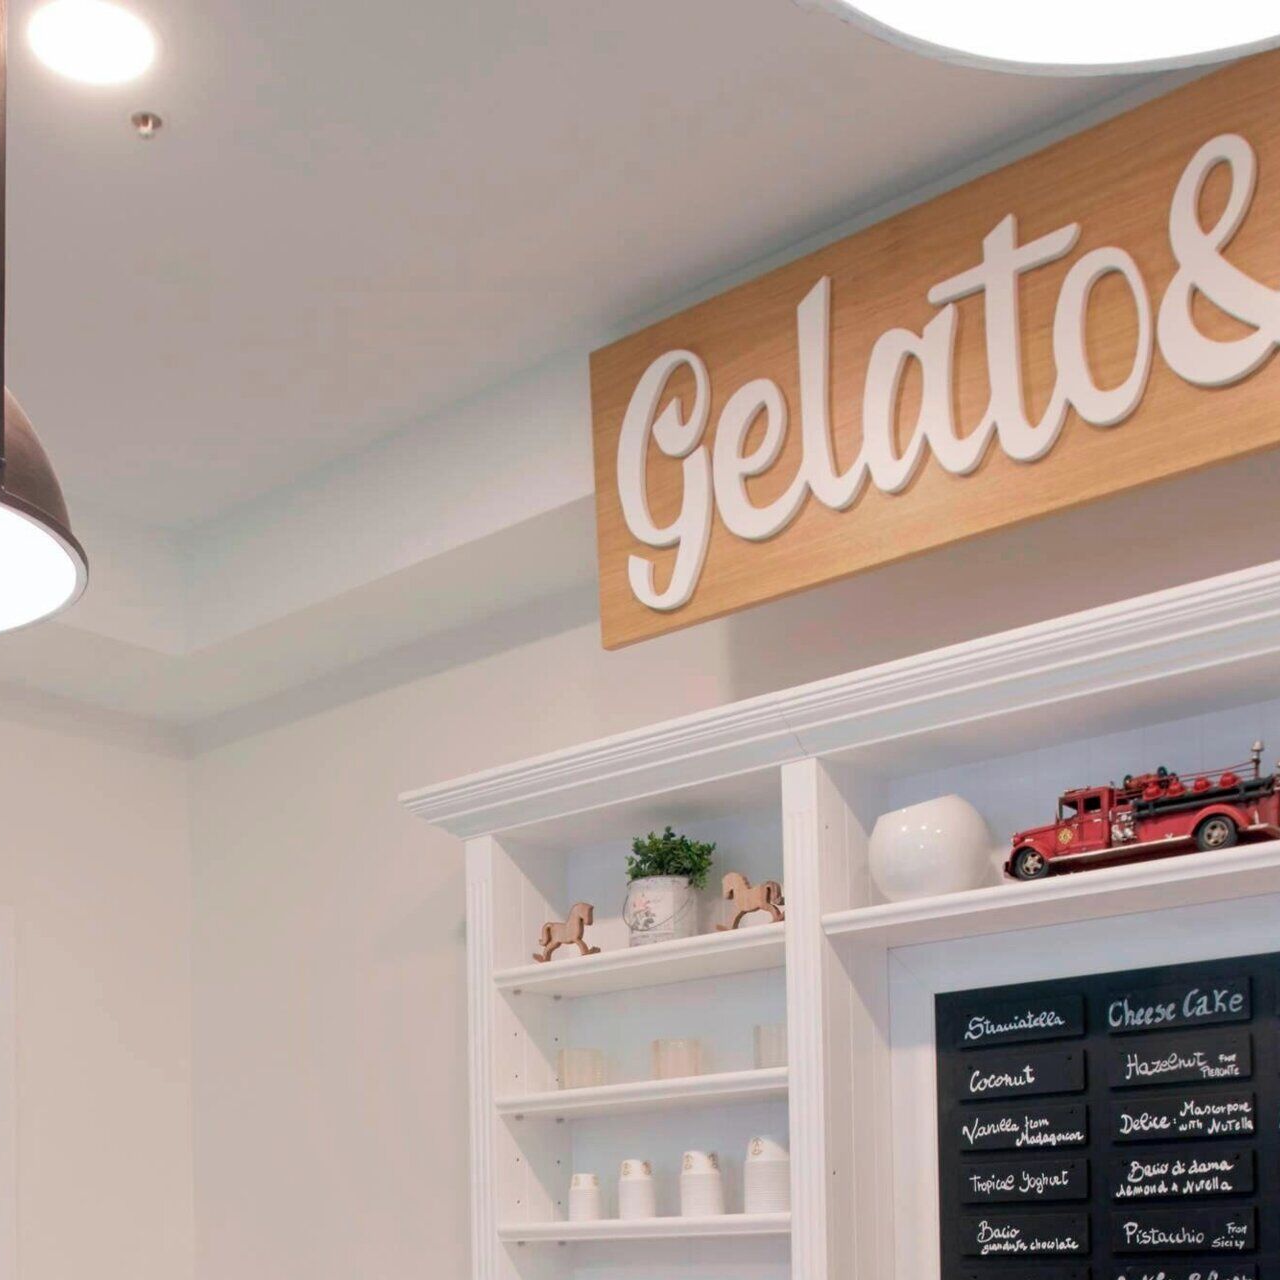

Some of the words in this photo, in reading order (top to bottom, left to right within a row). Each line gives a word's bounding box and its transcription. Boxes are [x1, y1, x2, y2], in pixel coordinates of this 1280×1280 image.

[1108, 998, 1177, 1027] Cheese
[969, 1065, 1036, 1093] Coconut
[1125, 1052, 1208, 1080] Hazelnut
[1171, 1160, 1186, 1176] di
[1188, 1159, 1234, 1175] dama
[1019, 1170, 1070, 1195] Yoghurt
[976, 1220, 1020, 1243] Bacio
